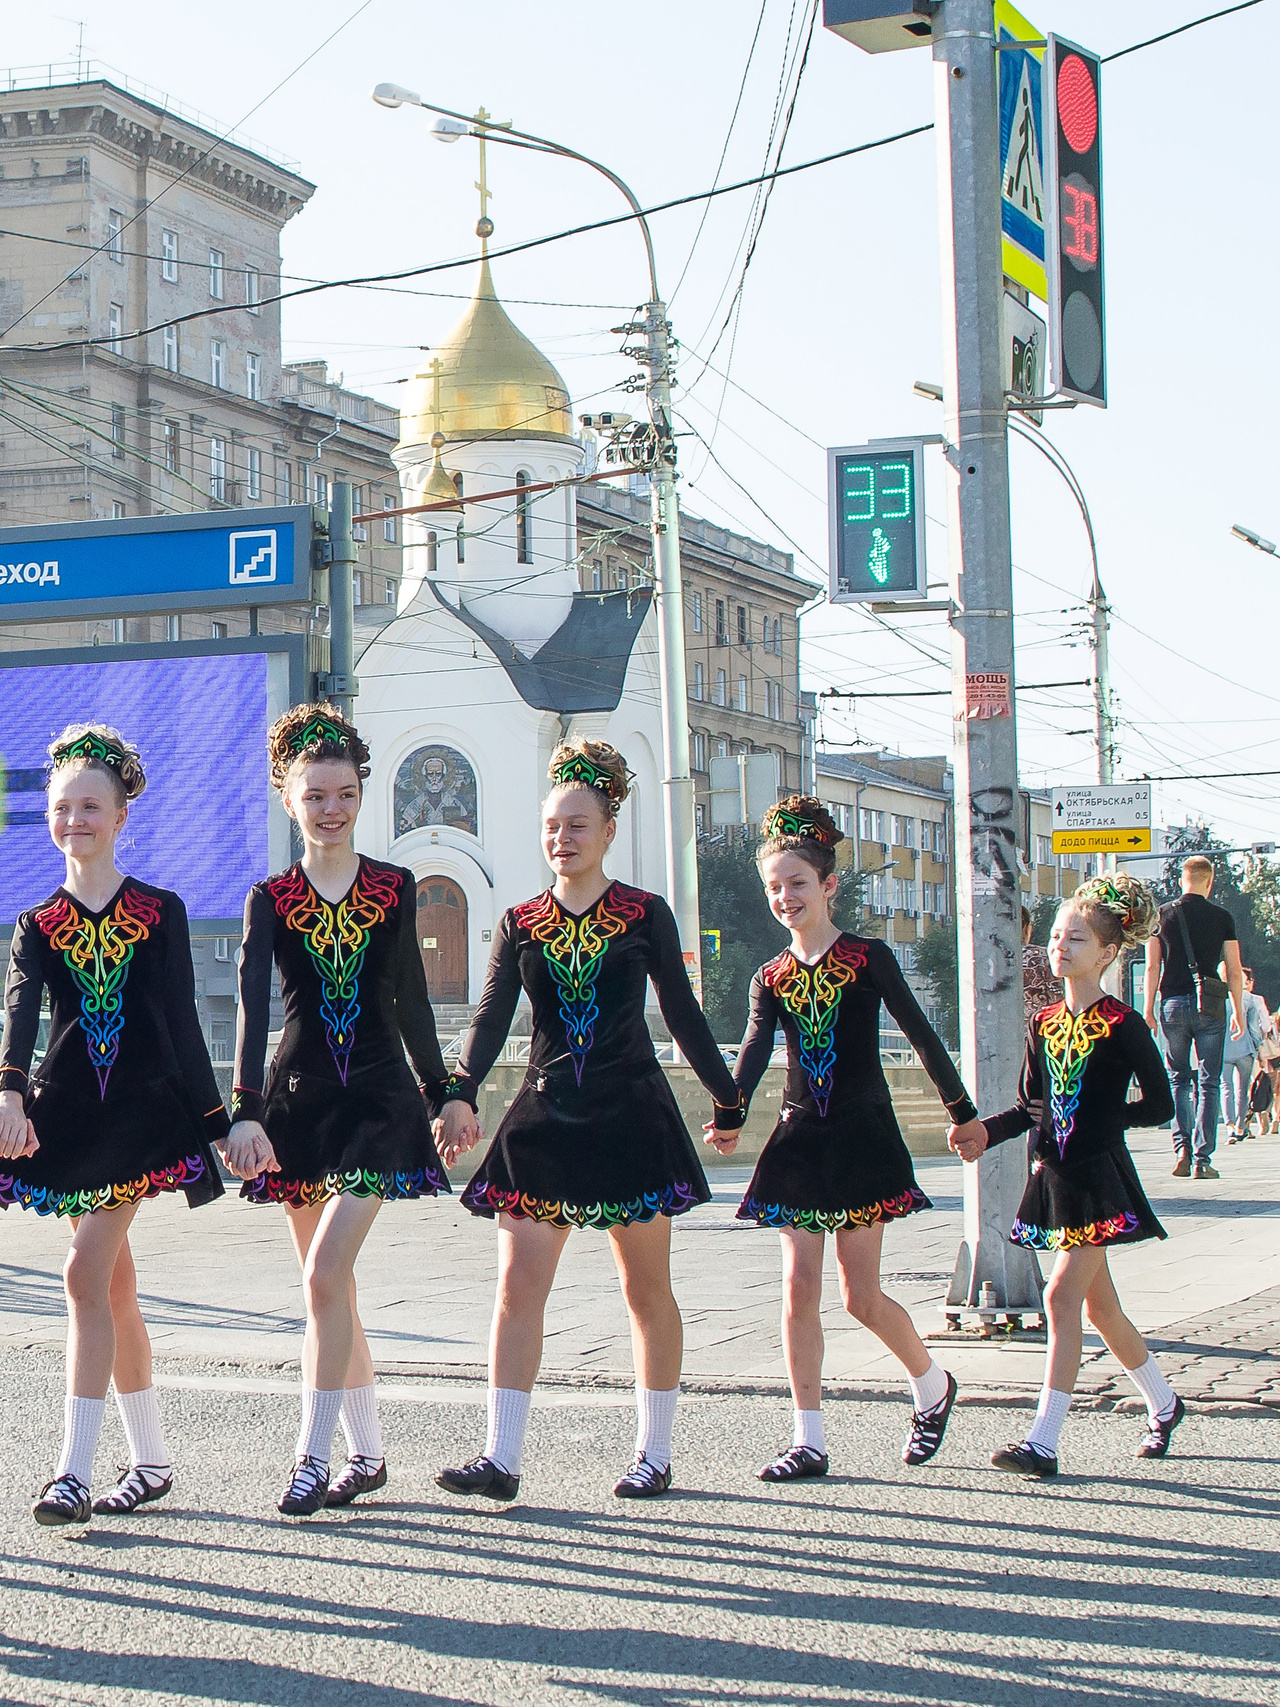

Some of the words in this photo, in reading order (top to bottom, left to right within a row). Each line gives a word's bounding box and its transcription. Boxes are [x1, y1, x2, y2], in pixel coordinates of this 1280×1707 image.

[1064, 185, 1097, 263] 38
[846, 464, 910, 521] 33
[1066, 790, 1092, 798] улица
[1135, 792, 1148, 800] 0.2
[1066, 797, 1134, 807] ОКТЯБРЬСКАЯ
[1066, 810, 1092, 818] улица
[1135, 812, 1148, 820] 0.5
[1066, 817, 1116, 827] СПАРТАКА
[1060, 837, 1086, 847] ДОДО
[1088, 837, 1120, 846] ПИЦЦА
